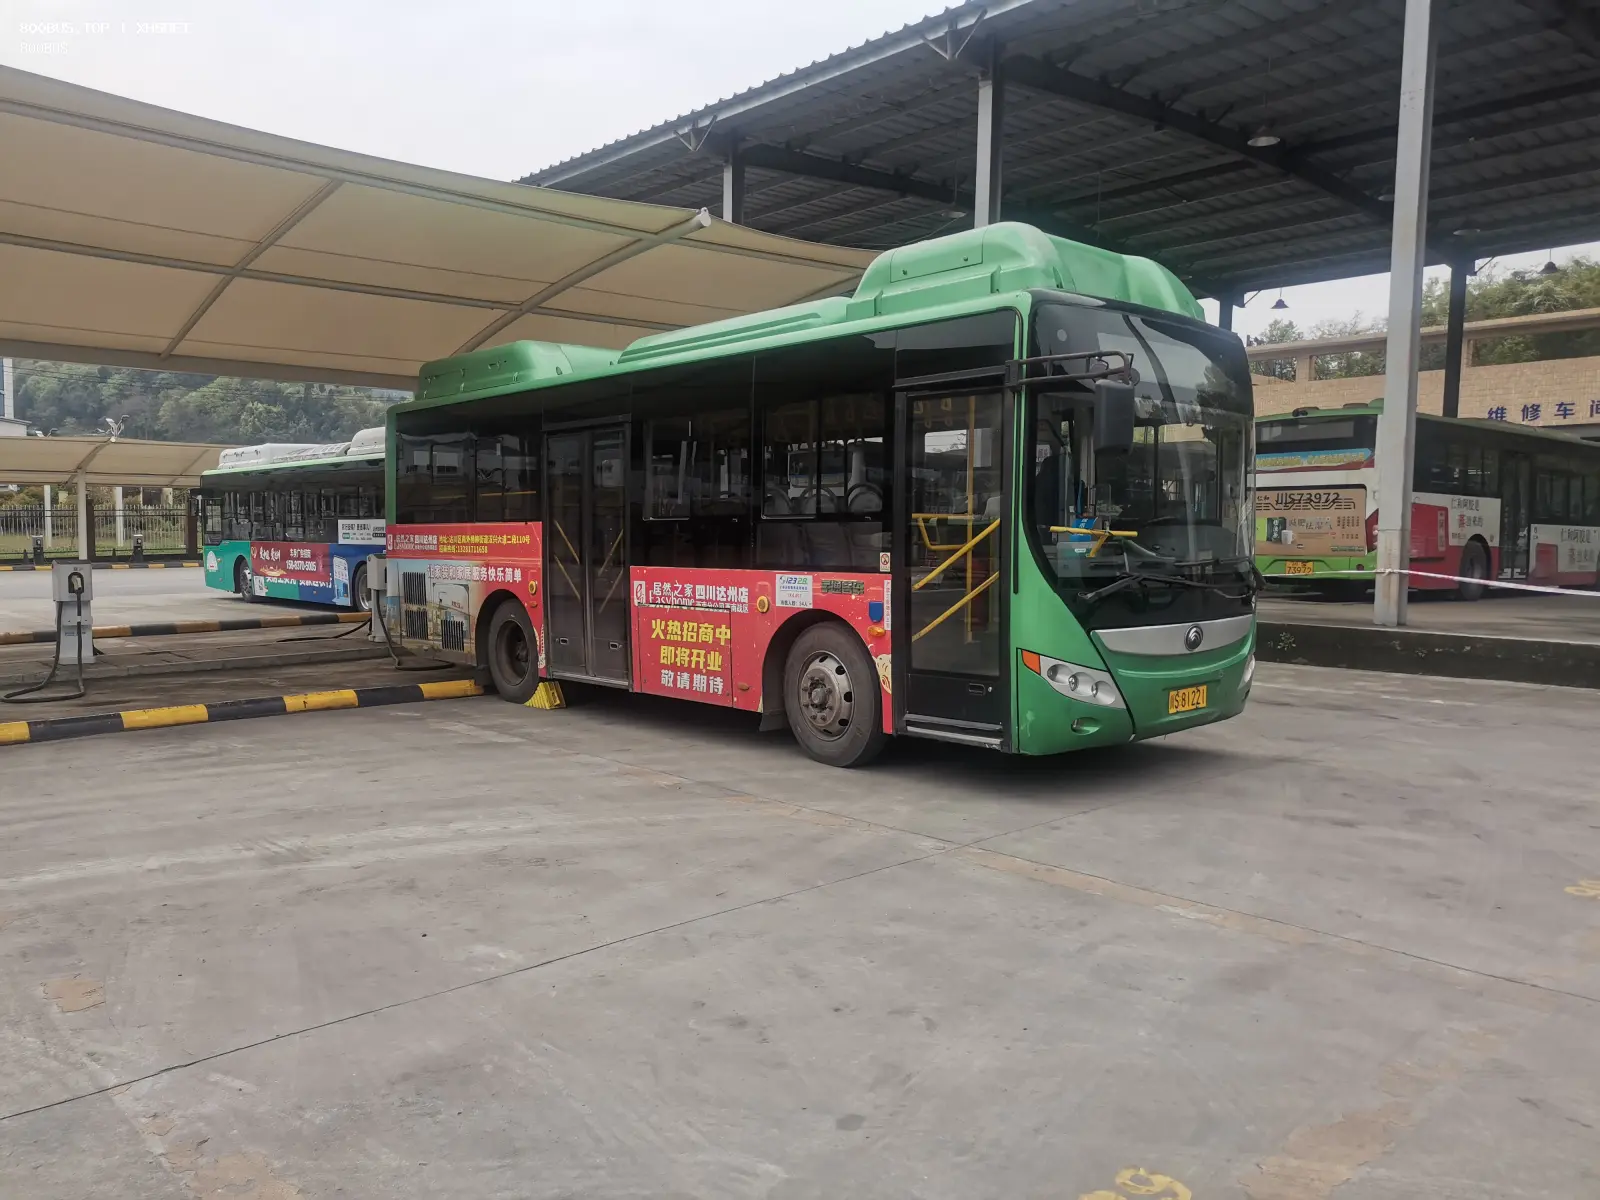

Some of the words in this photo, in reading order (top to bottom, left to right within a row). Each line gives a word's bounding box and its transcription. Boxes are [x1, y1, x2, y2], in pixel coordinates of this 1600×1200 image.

[653, 580, 694, 598] 居然之家
[695, 584, 749, 604] 四川达州店
[651, 618, 731, 646] 火热招商中
[660, 645, 723, 672] 即将开业
[660, 669, 724, 695] 敬请期待
